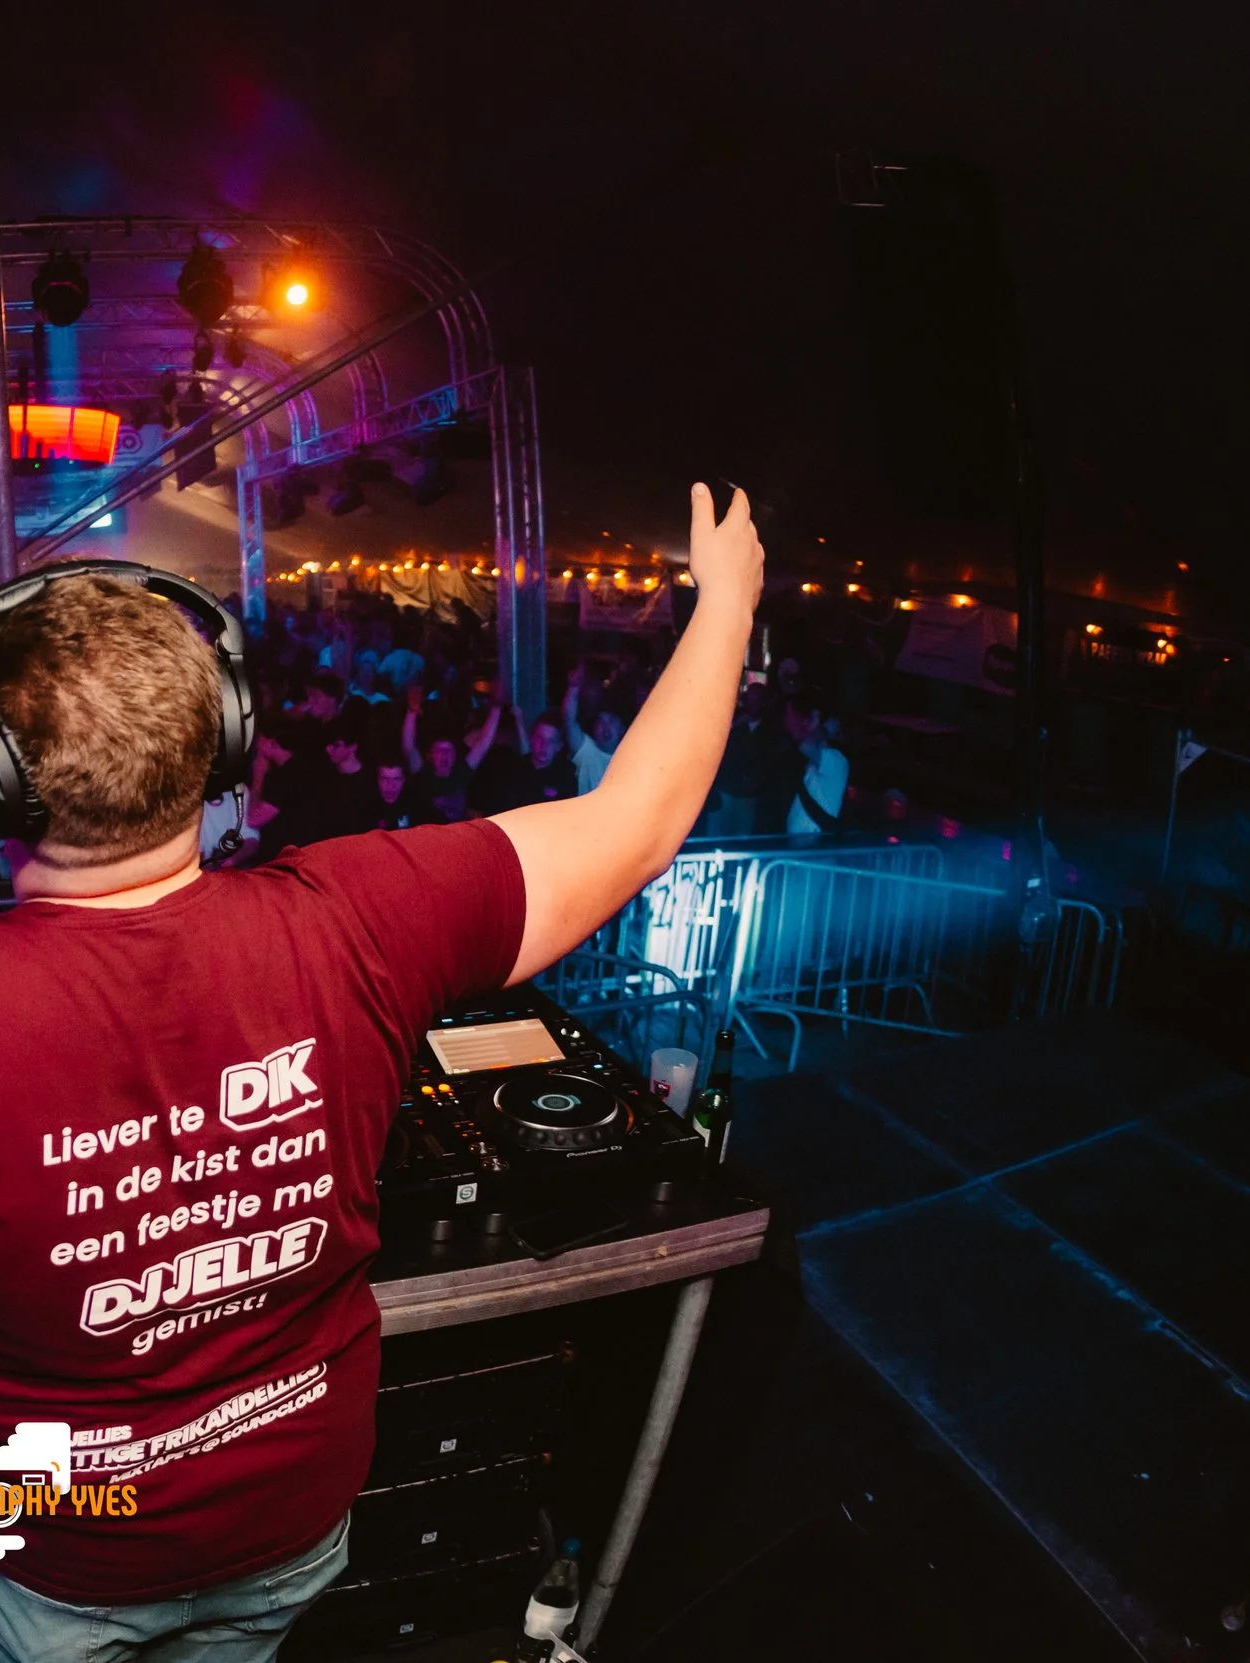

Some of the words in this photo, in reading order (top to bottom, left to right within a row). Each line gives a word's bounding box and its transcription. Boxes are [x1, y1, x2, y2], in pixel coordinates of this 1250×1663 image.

[42, 1114, 158, 1166] Liever
[169, 1105, 205, 1136] te
[221, 1040, 322, 1127] DIK
[66, 1182, 104, 1216] in
[115, 1166, 161, 1202] de
[171, 1145, 240, 1184] kist
[251, 1128, 327, 1168] dan
[50, 1229, 125, 1266] een
[137, 1190, 262, 1247] feestje
[273, 1173, 334, 1211] me
[131, 1291, 269, 1357] gemist!
[70, 1442, 146, 1468] TTIGE
[149, 1363, 321, 1457] FRIKANDELLIES
[221, 1381, 328, 1444] SOUNDCLOUD
